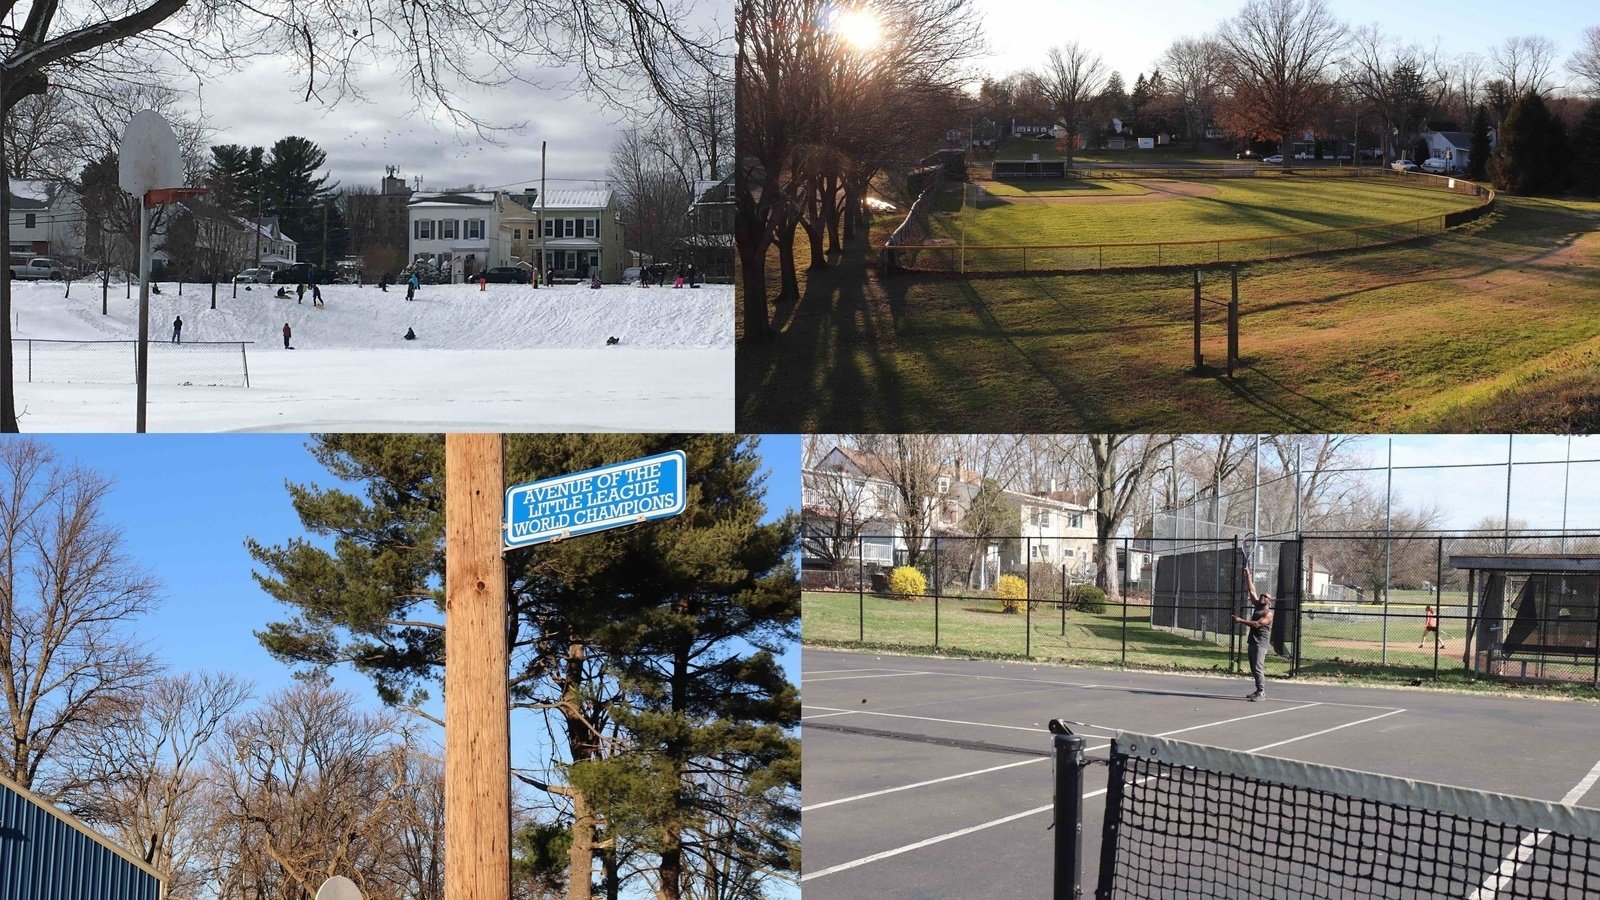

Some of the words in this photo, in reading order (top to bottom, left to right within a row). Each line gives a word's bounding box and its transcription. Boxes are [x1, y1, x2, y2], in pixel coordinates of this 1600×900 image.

[523, 478, 593, 504] AVENUE
[597, 472, 622, 488] OF
[626, 463, 661, 482] THE
[528, 495, 583, 518] LITTLE
[588, 480, 659, 506] LEAGUE
[514, 513, 570, 536] WORLD
[574, 493, 674, 523] CHAMPIONS
